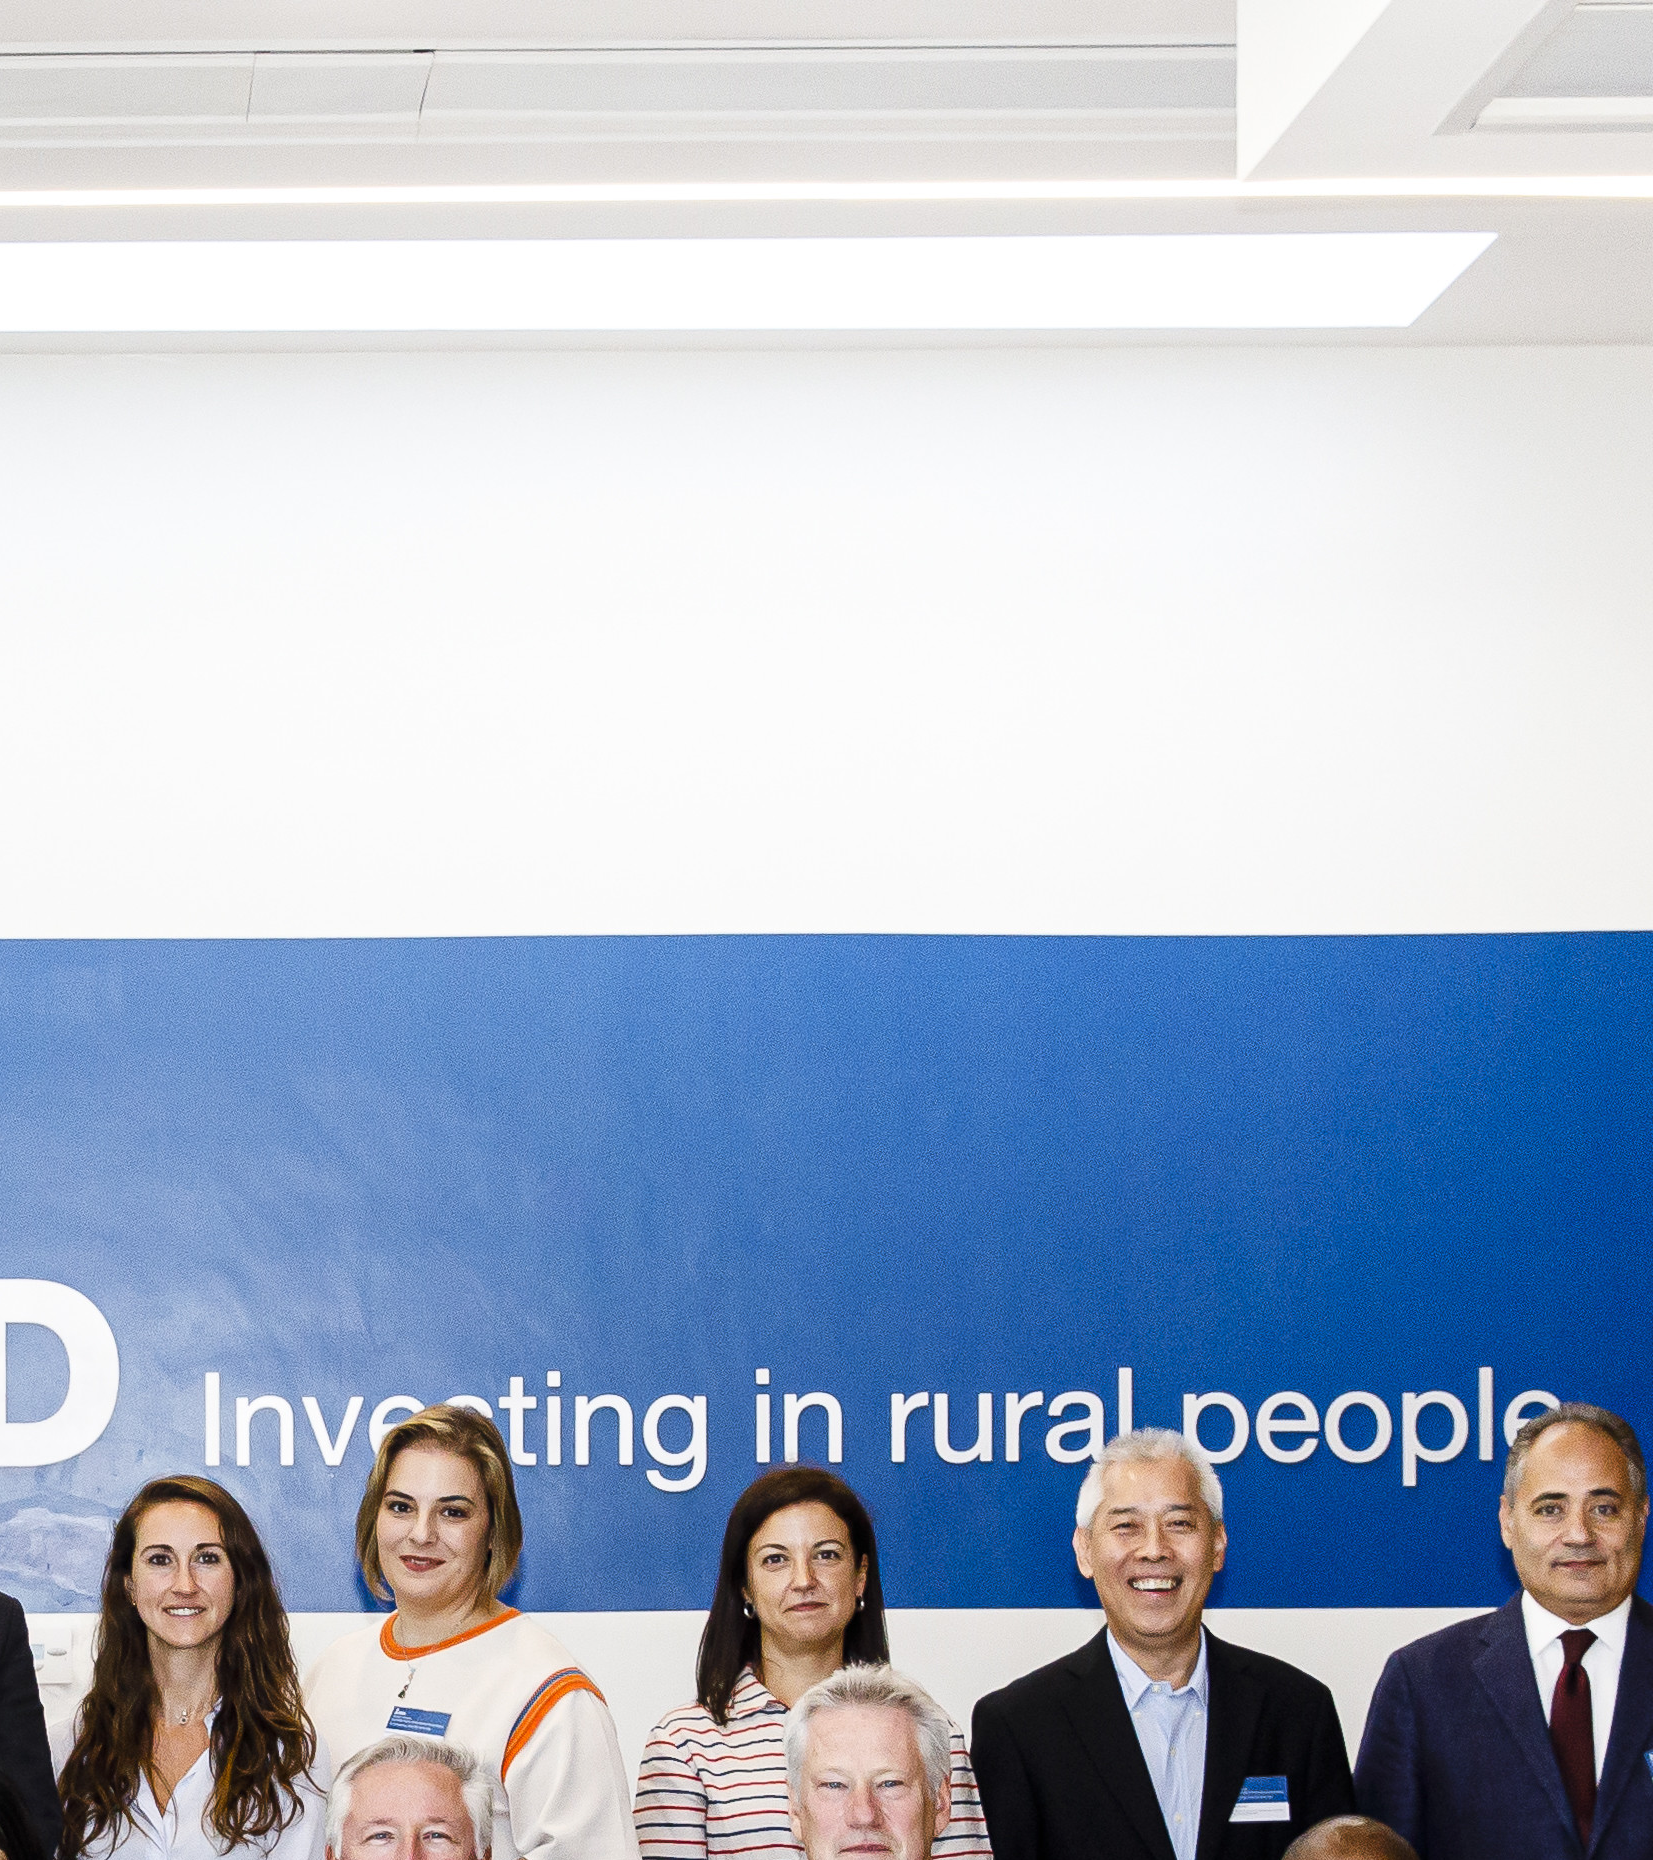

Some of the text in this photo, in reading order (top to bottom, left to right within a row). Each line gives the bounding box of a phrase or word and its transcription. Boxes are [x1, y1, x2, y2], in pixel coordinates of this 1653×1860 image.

[203, 1371, 708, 1492] Inveting
[754, 1367, 843, 1464] in
[889, 1367, 1133, 1464] rural
